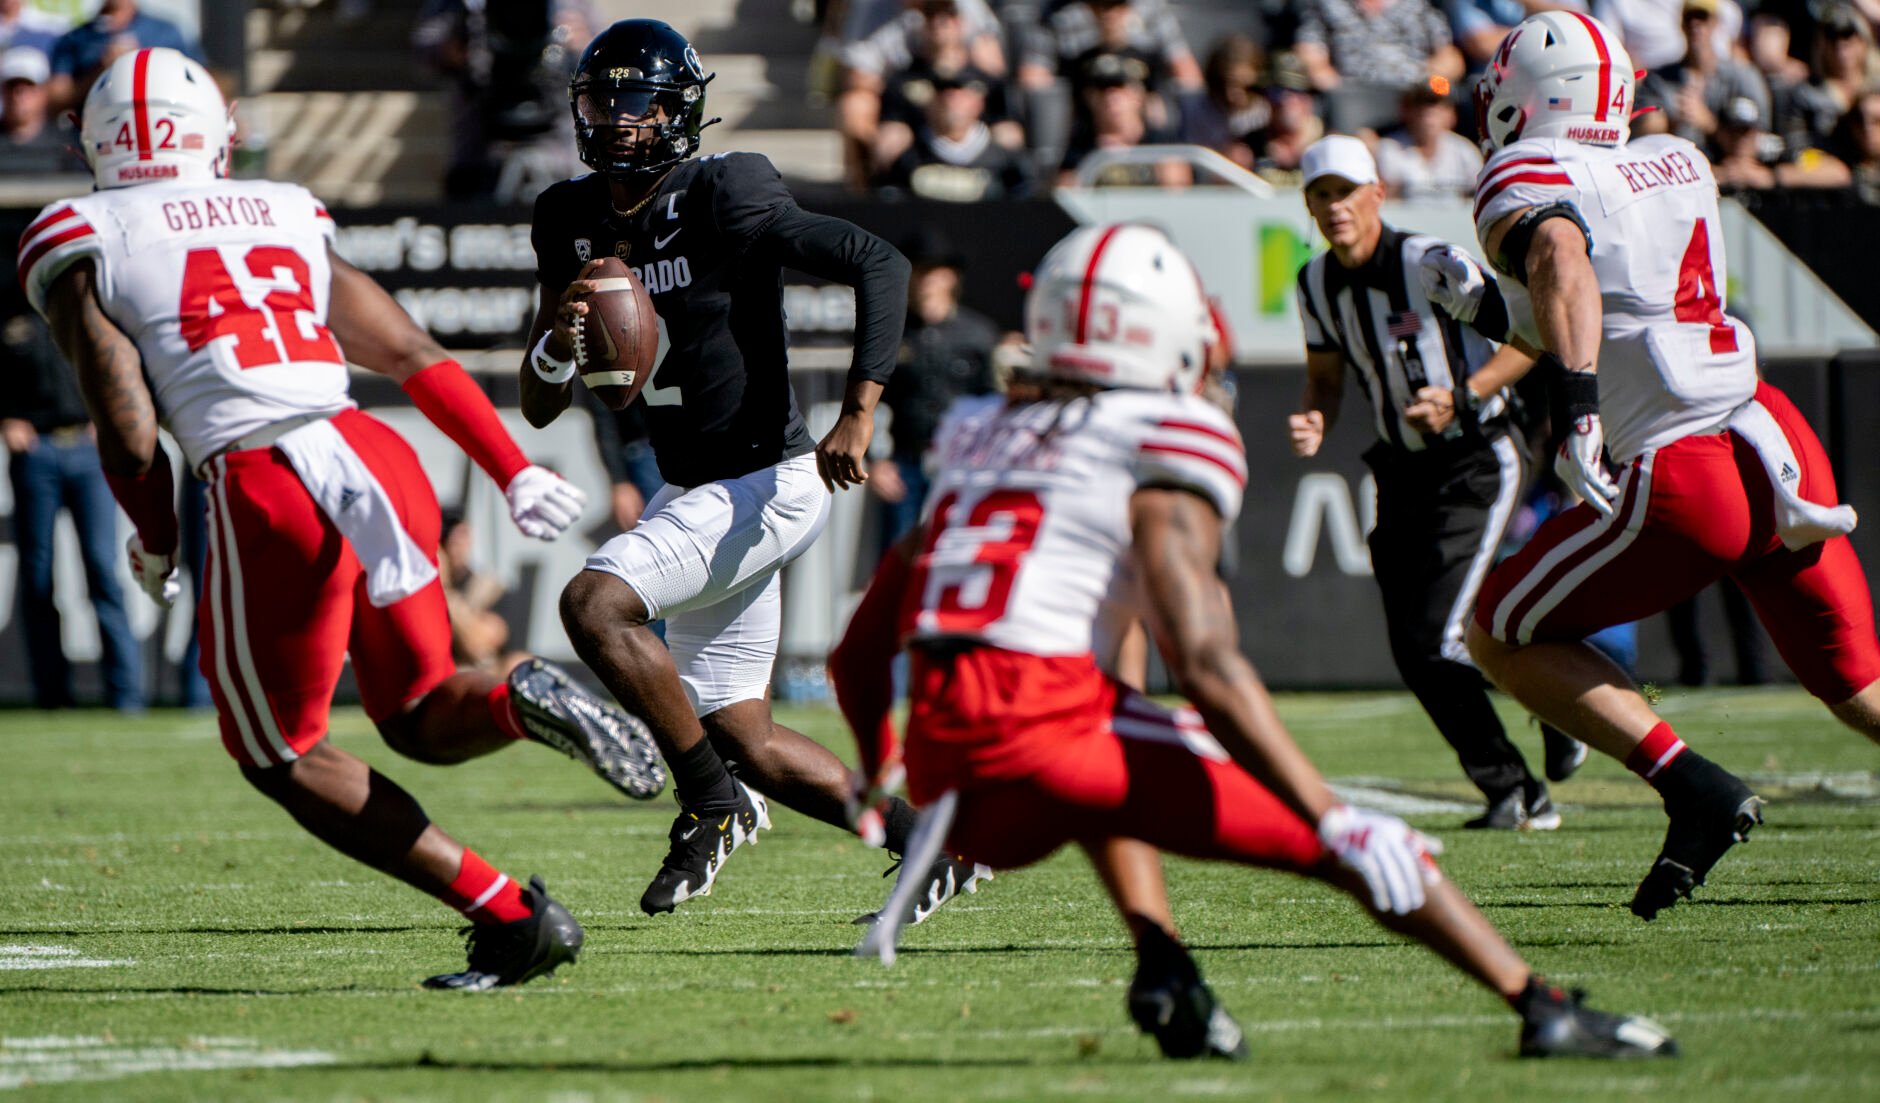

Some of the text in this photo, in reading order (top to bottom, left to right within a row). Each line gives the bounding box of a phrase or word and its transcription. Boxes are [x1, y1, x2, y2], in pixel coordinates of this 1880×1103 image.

[1611, 84, 1625, 115] 4
[1567, 126, 1621, 145] HUSKERS
[117, 164, 180, 182] HUSKERS
[1616, 151, 1701, 194] REIMER
[162, 196, 276, 232] GBAYOR
[1674, 217, 1740, 356] 4
[179, 244, 345, 371] 42
